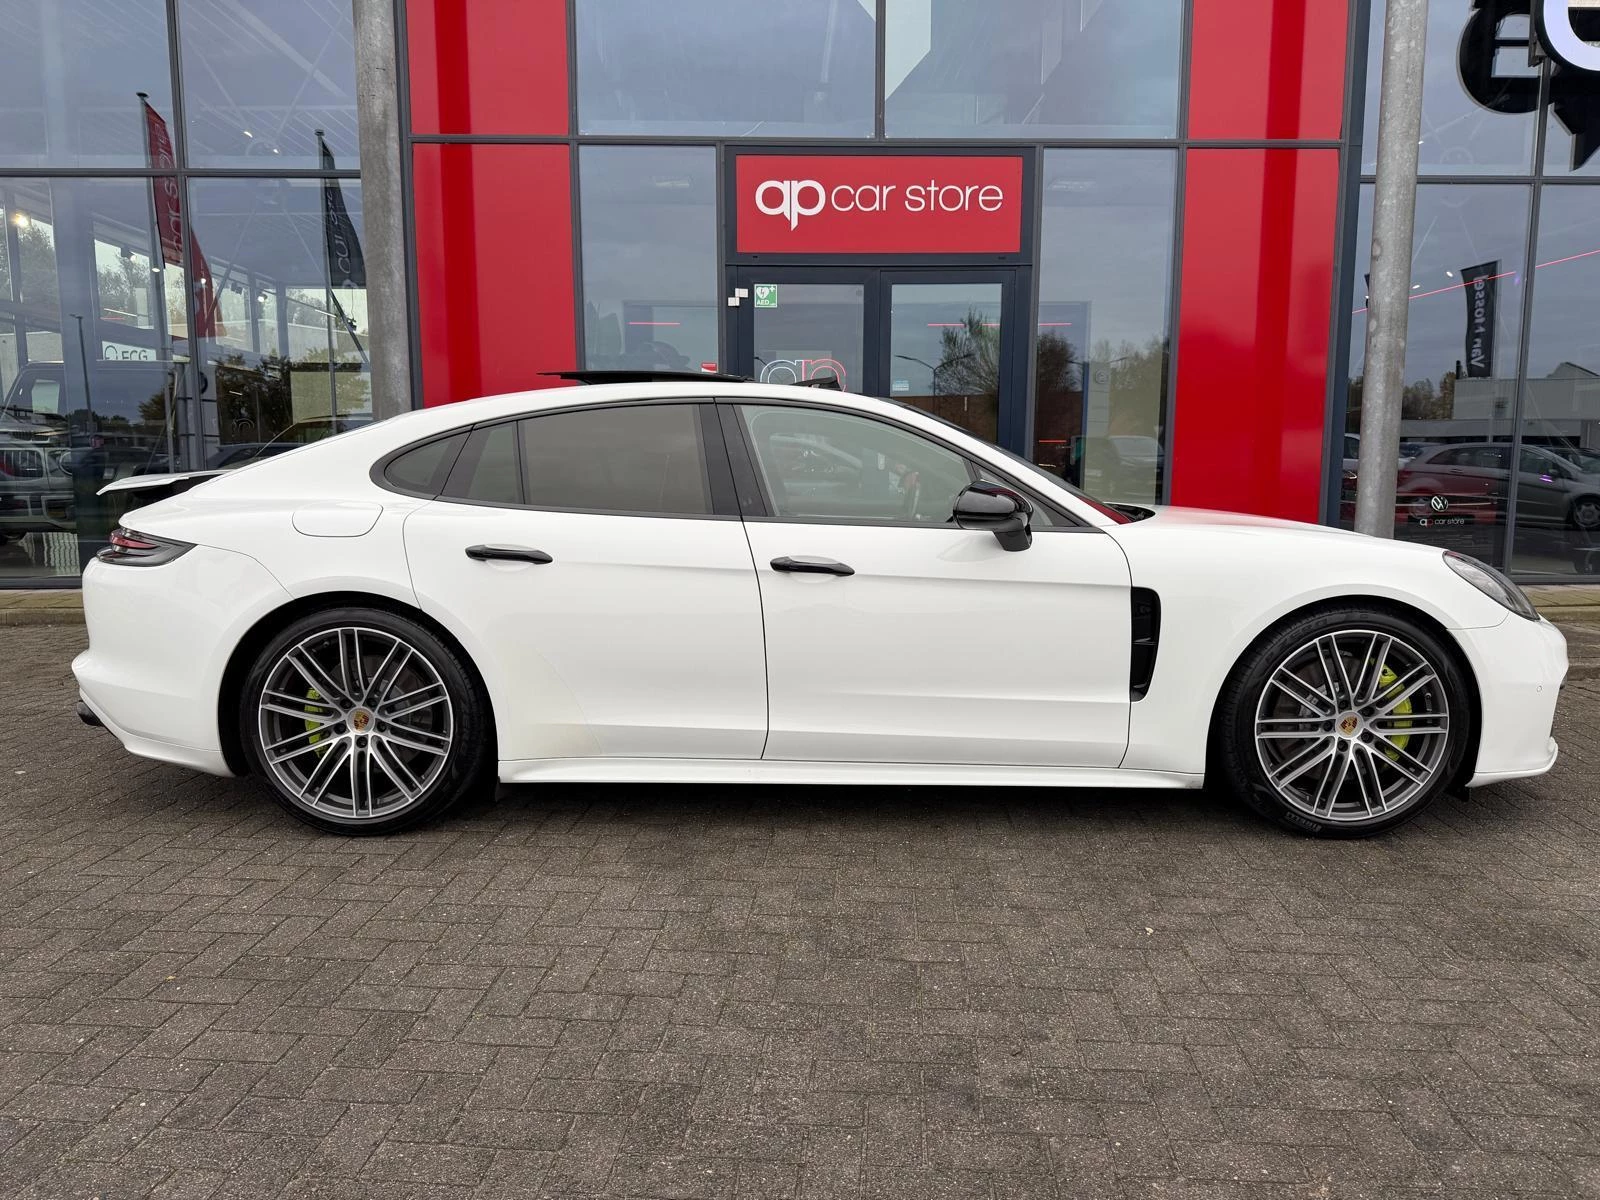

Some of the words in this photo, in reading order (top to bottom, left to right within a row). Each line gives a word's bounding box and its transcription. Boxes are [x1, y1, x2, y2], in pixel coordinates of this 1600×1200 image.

[755, 179, 826, 232] ap
[831, 185, 896, 212] car
[904, 179, 1003, 212] store
